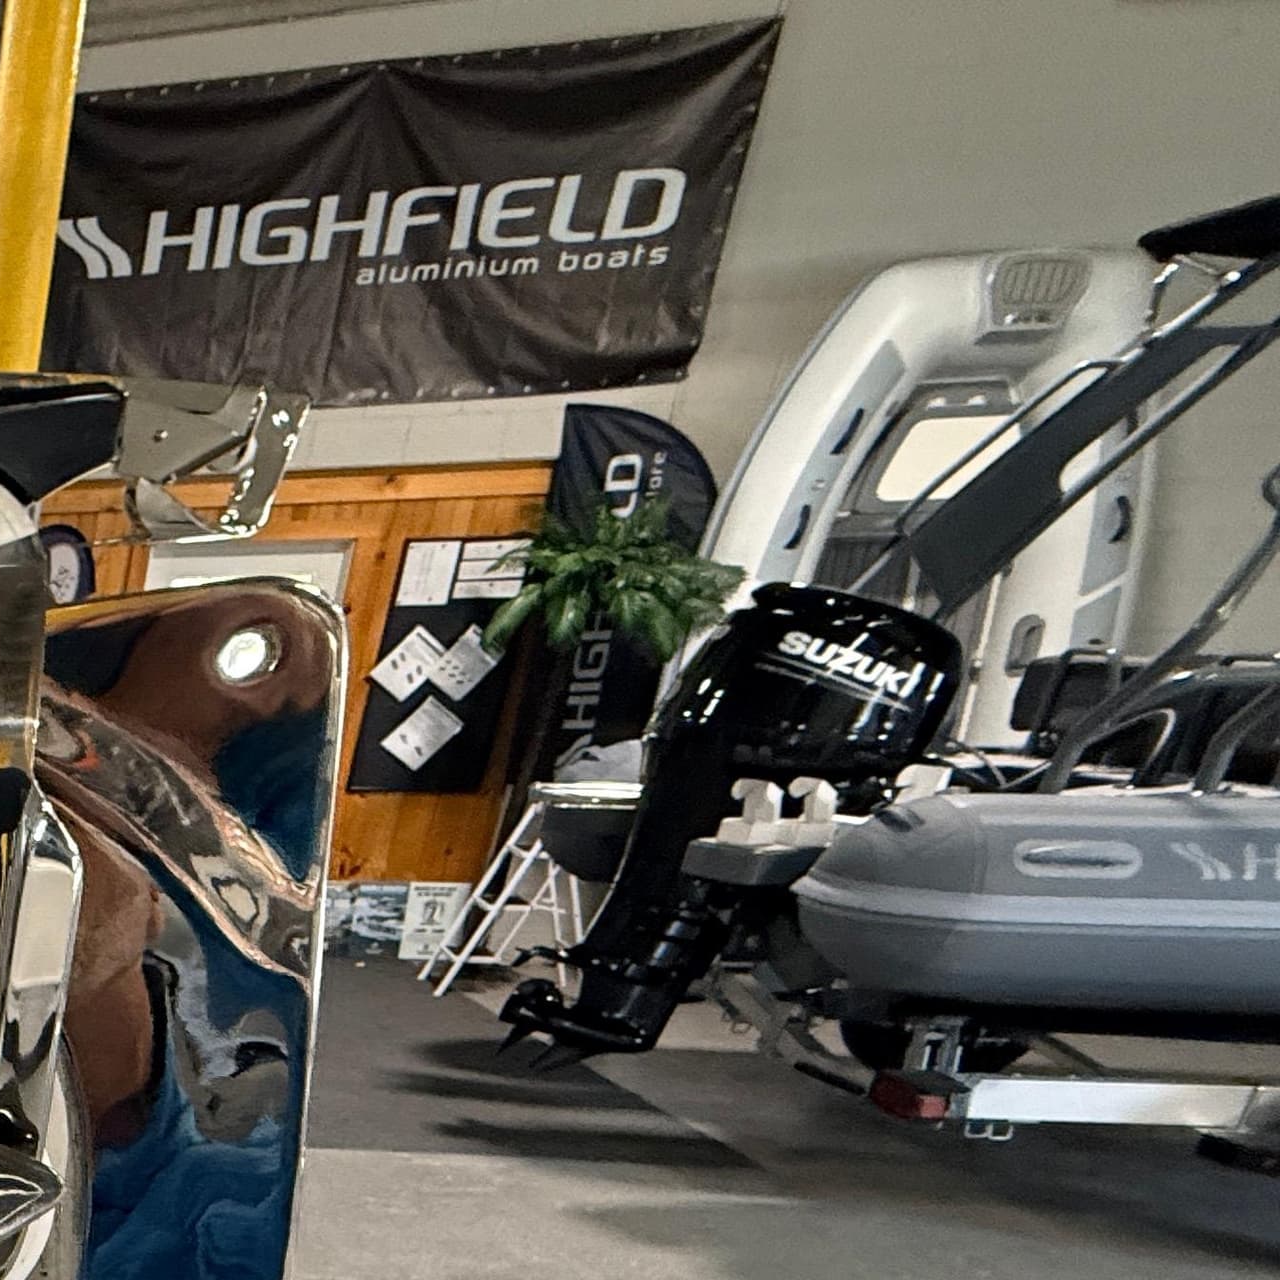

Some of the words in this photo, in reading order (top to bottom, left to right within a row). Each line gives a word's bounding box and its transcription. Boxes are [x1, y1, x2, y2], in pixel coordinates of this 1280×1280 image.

[141, 168, 686, 275] HIGHFIELD
[356, 255, 539, 286] aluminium
[558, 244, 670, 273] boats
[778, 631, 925, 699] SUZUKI
